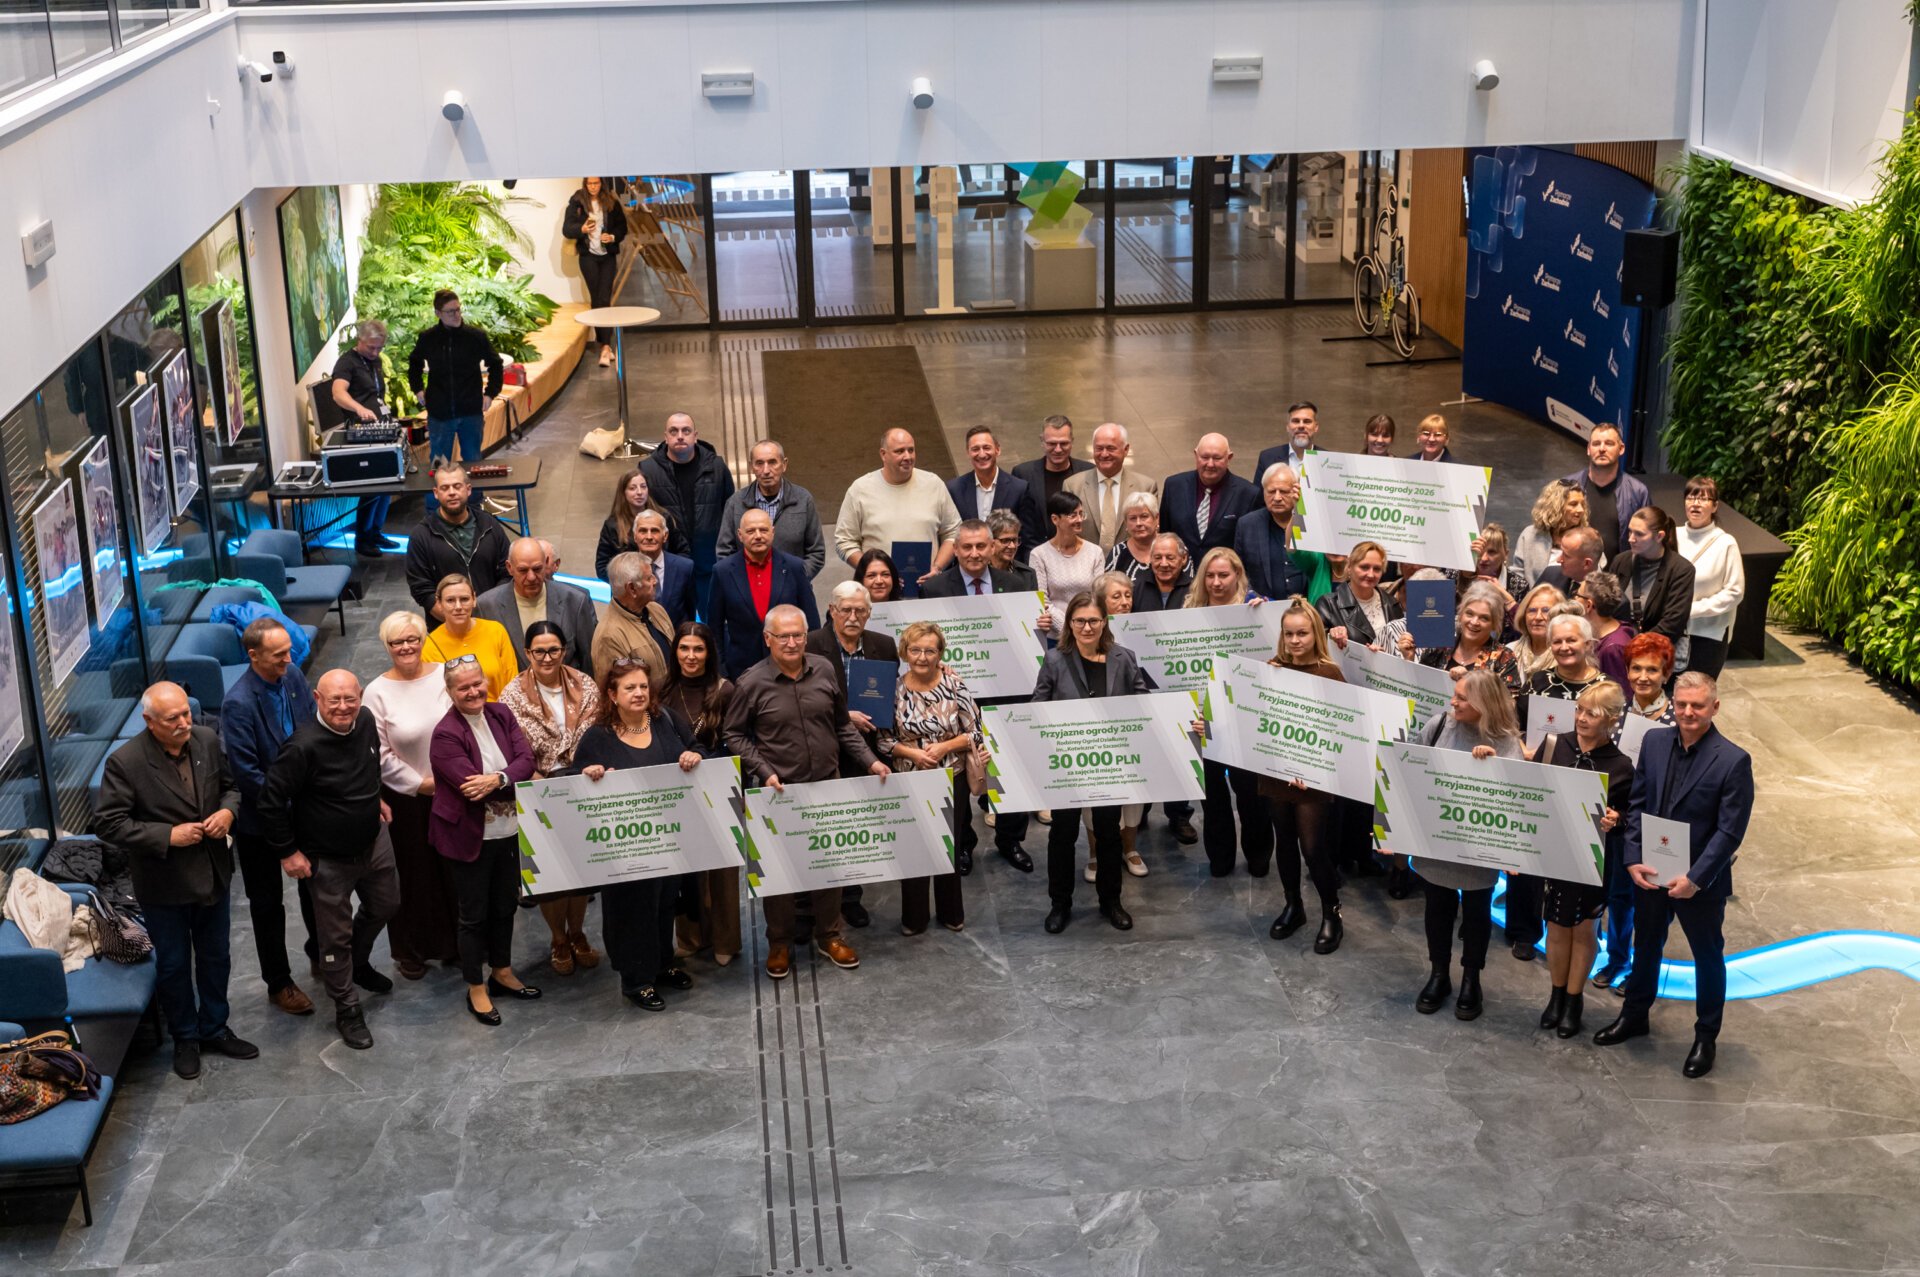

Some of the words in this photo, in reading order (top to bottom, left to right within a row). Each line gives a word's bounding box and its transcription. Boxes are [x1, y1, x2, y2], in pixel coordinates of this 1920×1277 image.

[1346, 480, 1383, 490] Przyjazne
[1384, 486, 1413, 495] ogrody
[1414, 488, 1434, 496] 2026
[1346, 504, 1367, 519] 40
[1370, 506, 1401, 523] 000
[1403, 515, 1425, 526] PLN
[942, 623, 969, 633] ogrody
[971, 622, 992, 630] 2026
[1155, 637, 1198, 646] Przyjazne
[1199, 633, 1230, 643] ogrody
[1232, 631, 1254, 639] 2026
[966, 650, 989, 661] PLN
[1164, 660, 1187, 675] 20
[1366, 675, 1398, 693] Przyjazne
[1399, 688, 1425, 702] ogrody
[1426, 694, 1445, 707] 2026
[1258, 691, 1299, 708] Przyjazne
[1300, 704, 1331, 718] ogrody
[1331, 711, 1354, 722] 2026
[1284, 710, 1304, 719] Związek
[1305, 715, 1337, 727] Działkowców
[1040, 729, 1084, 739] Przyjazne
[1085, 725, 1118, 736] ogrody
[1120, 724, 1143, 732] 2026
[1257, 717, 1280, 736] 30
[1283, 725, 1317, 746] 000
[1318, 738, 1342, 753] PLN
[1278, 740, 1297, 749] zajęcie
[1301, 747, 1322, 755] miejsca
[1048, 753, 1072, 769] 30
[1076, 751, 1112, 767] 000
[1115, 754, 1140, 765] PLN
[1434, 777, 1481, 792] Przyjazne
[1482, 787, 1517, 799] ogrody
[1519, 791, 1543, 801] 2026
[577, 801, 624, 812] Przyjazne
[625, 795, 659, 807] ogrody
[661, 791, 684, 801] 2026
[1451, 792, 1494, 803] Stowarzyszenie
[1494, 799, 1525, 808] Ogrodowe
[612, 808, 634, 816] Ogrody
[635, 811, 662, 819] Szczecinie
[801, 809, 844, 820] Przyjazne
[845, 804, 877, 816] ogrody
[879, 802, 900, 810] 2026
[1439, 804, 1465, 822] 20
[1468, 809, 1507, 829] 000
[1510, 820, 1536, 834] PLN
[585, 826, 611, 843] 40
[614, 821, 652, 839] 000
[655, 822, 680, 835] PLN
[808, 834, 831, 850] 20
[834, 830, 870, 847] 000
[872, 832, 895, 843] PLN
[1493, 830, 1516, 838] miejsca
